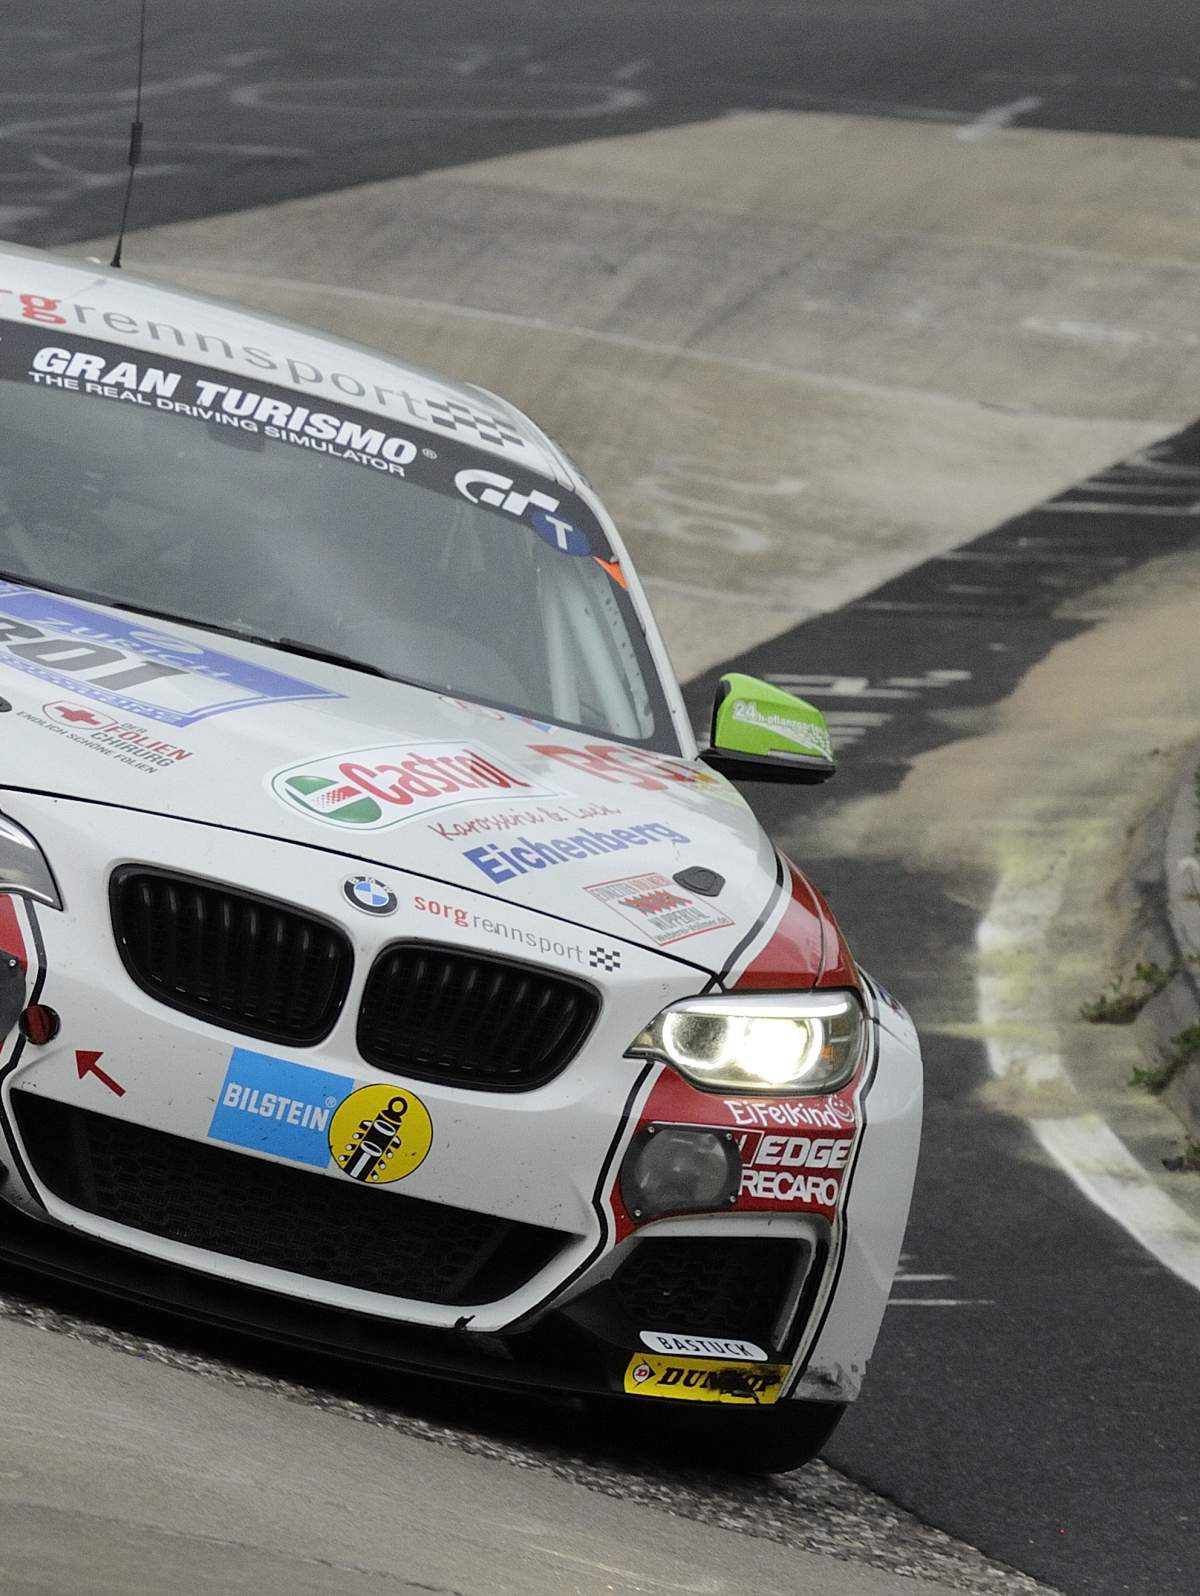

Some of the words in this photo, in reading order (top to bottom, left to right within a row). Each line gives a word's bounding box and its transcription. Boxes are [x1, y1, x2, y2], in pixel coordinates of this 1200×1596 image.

[32, 346, 182, 398] GRAN
[28, 370, 80, 391] THE
[85, 382, 152, 406] REAL
[155, 398, 259, 433] DRIVING
[264, 424, 406, 478] SIMULATOR
[546, 514, 574, 550] T
[40, 617, 232, 680] ZURICH
[15, 710, 71, 737] ENDLICH
[113, 752, 159, 775] FOLIEN
[90, 731, 176, 768] CHIRURG
[104, 725, 193, 761] FOLIEN
[121, 722, 148, 734] DER
[337, 749, 536, 807] Castrol
[461, 822, 692, 885] Eichenberg
[222, 1082, 330, 1133] BILSTEIN
[754, 1134, 853, 1169] EDGE
[737, 1168, 839, 1207] RECARO
[656, 1336, 755, 1358] BASTUCK
